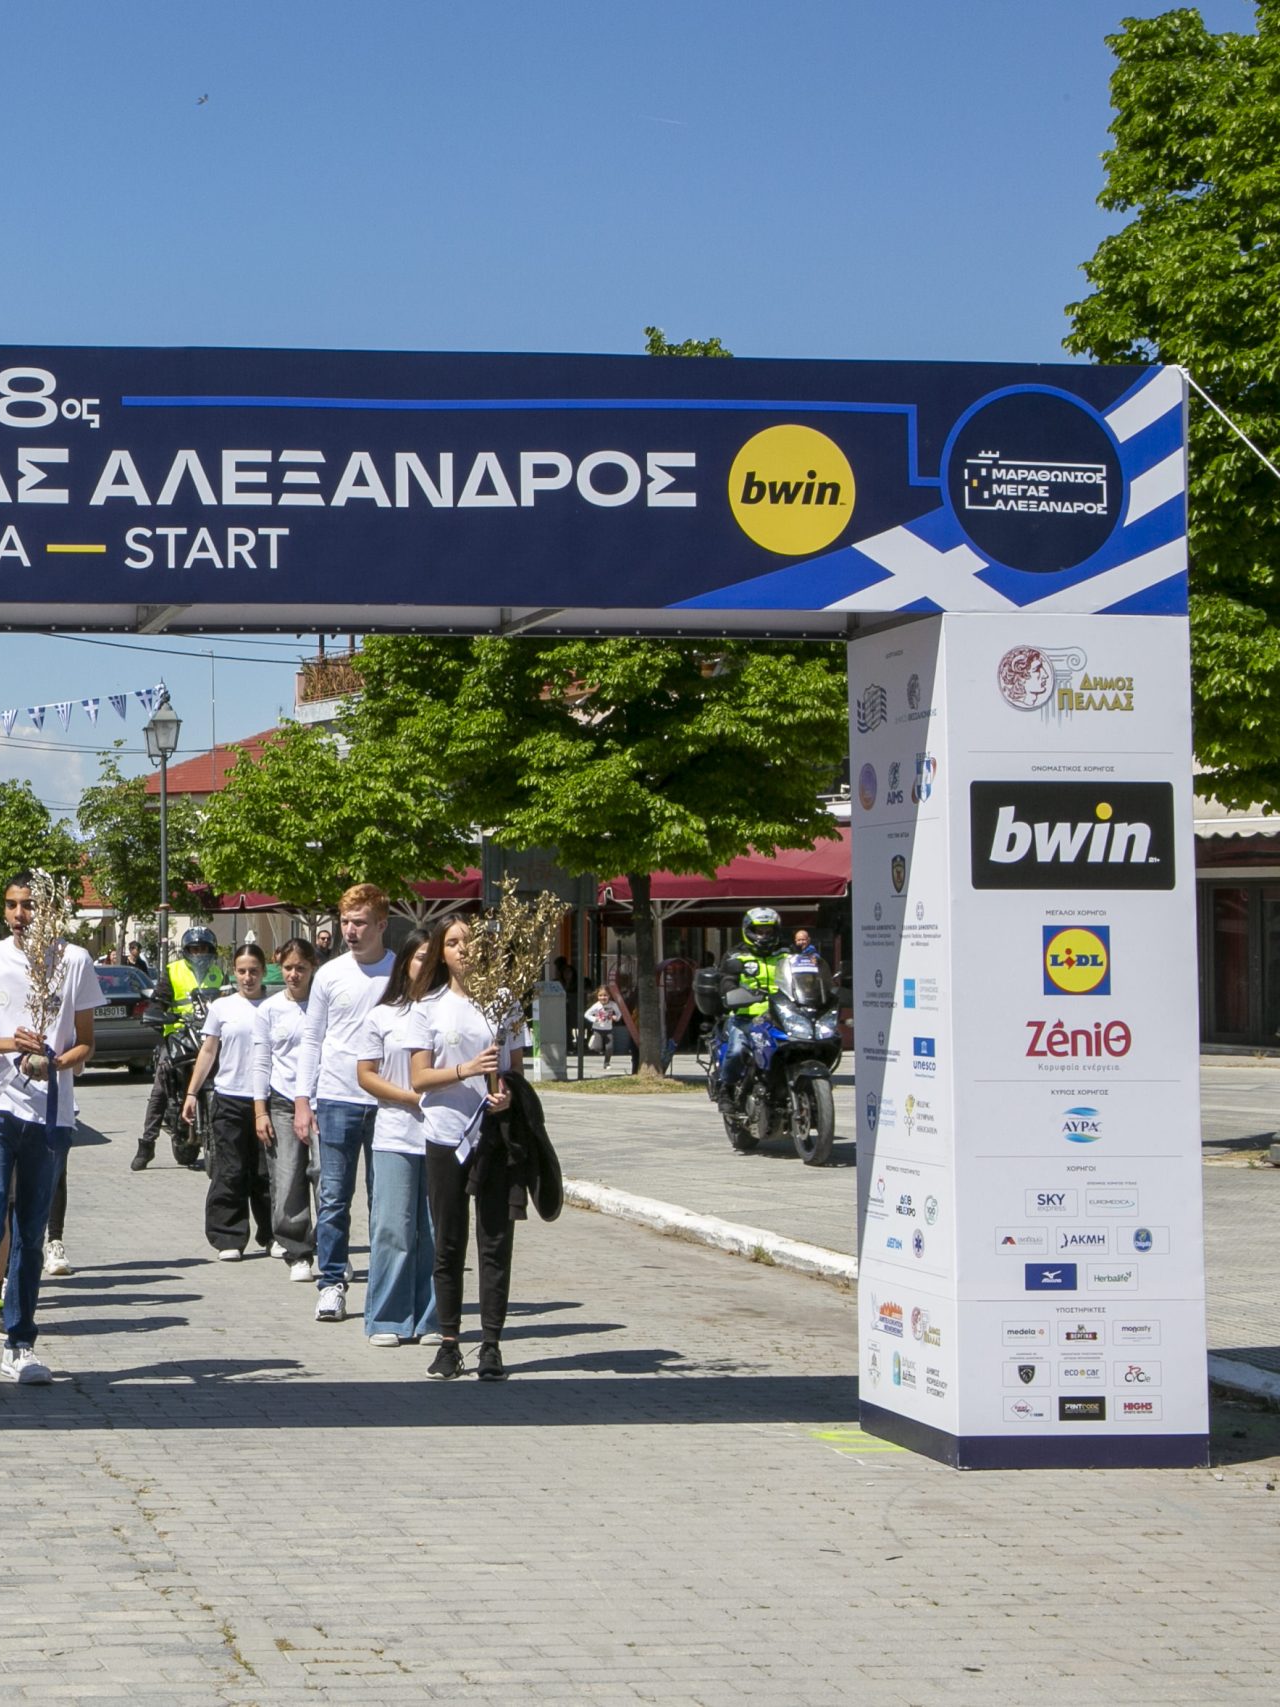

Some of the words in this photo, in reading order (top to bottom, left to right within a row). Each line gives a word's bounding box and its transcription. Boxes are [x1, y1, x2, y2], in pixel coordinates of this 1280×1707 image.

[88, 449, 697, 508] ΑΛΕΞΑΝΔΡΟΣ
[991, 467, 1103, 485] ΜΑΡΑΘΩΝΙΟΣ
[740, 469, 842, 506] bwin
[991, 483, 1050, 498] ΜΕΓΑΣ
[994, 499, 1108, 515] ΑΛΕΞΑΝΔΡΟΣ
[124, 526, 290, 570] START
[1079, 672, 1135, 691] ΔΗΜΟΣ
[1057, 688, 1135, 711] ΠΕΛΛΑΣ
[1031, 765, 1082, 773] ΟΝΟΜΑΣΤΙΚΟΣ
[1083, 765, 1115, 773] ΧΟΡΗΓΟΣ
[886, 791, 904, 806] AIMS
[988, 801, 1152, 863] bwin
[1045, 909, 1076, 917] ΜΕΓΑΛΟΙ
[1076, 909, 1107, 917] ΧΟΡΗΓΟΙ
[912, 1060, 936, 1071] unesco
[1038, 1063, 1079, 1072] Κορυφαία
[1037, 1193, 1066, 1206] SKY
[1070, 1235, 1106, 1245] ΑΚΜΗ
[1094, 1275, 1129, 1283] Herbalife
[1055, 1306, 1107, 1314] ΥΠΟΣΤΗΡΙΚΤΕΣ
[1006, 1328, 1036, 1336] medela
[1064, 1369, 1079, 1377] eco
[1086, 1369, 1100, 1377] car
